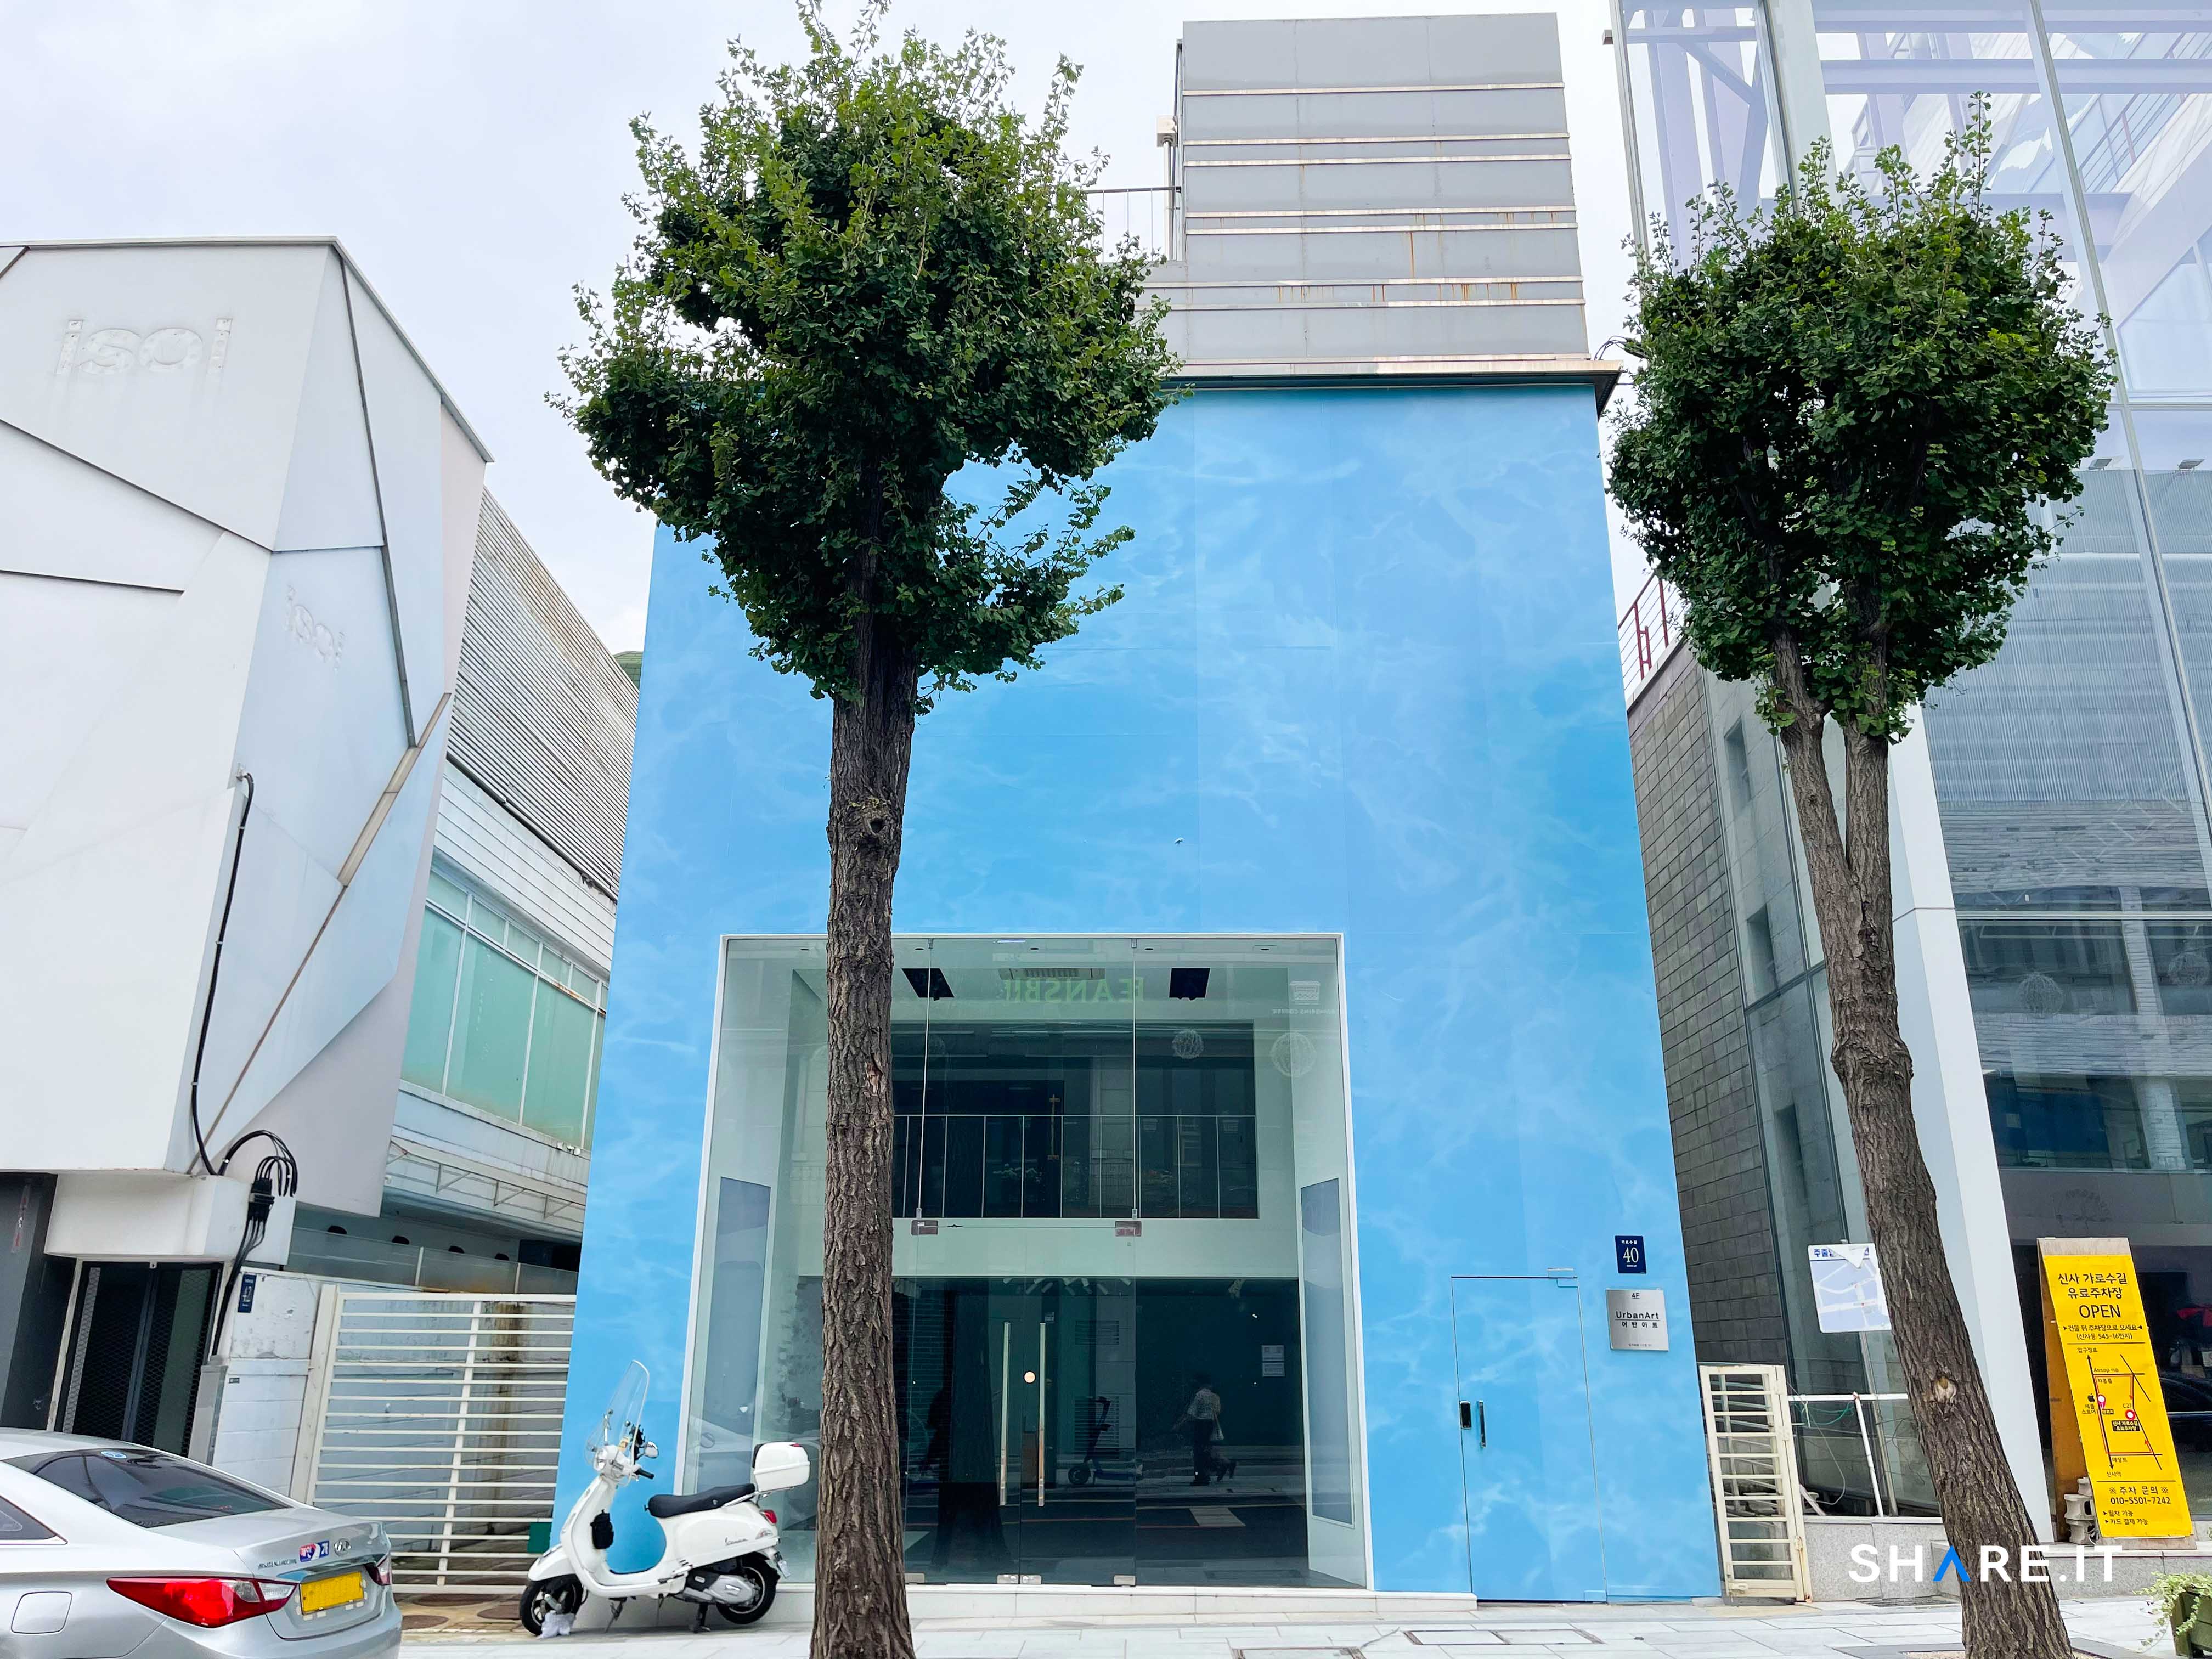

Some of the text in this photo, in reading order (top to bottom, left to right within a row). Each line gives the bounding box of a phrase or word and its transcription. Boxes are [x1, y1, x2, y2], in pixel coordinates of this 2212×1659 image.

[1623, 1246, 1639, 1263] 40
[2058, 1272, 2128, 1285] 신사 가로수길
[2068, 1287, 2123, 1299] 유료주차장
[1616, 1311, 1659, 1319] UrbanArt
[2079, 1305, 2121, 1318] OPEN
[2120, 1486, 2158, 1495] 주차 문의
